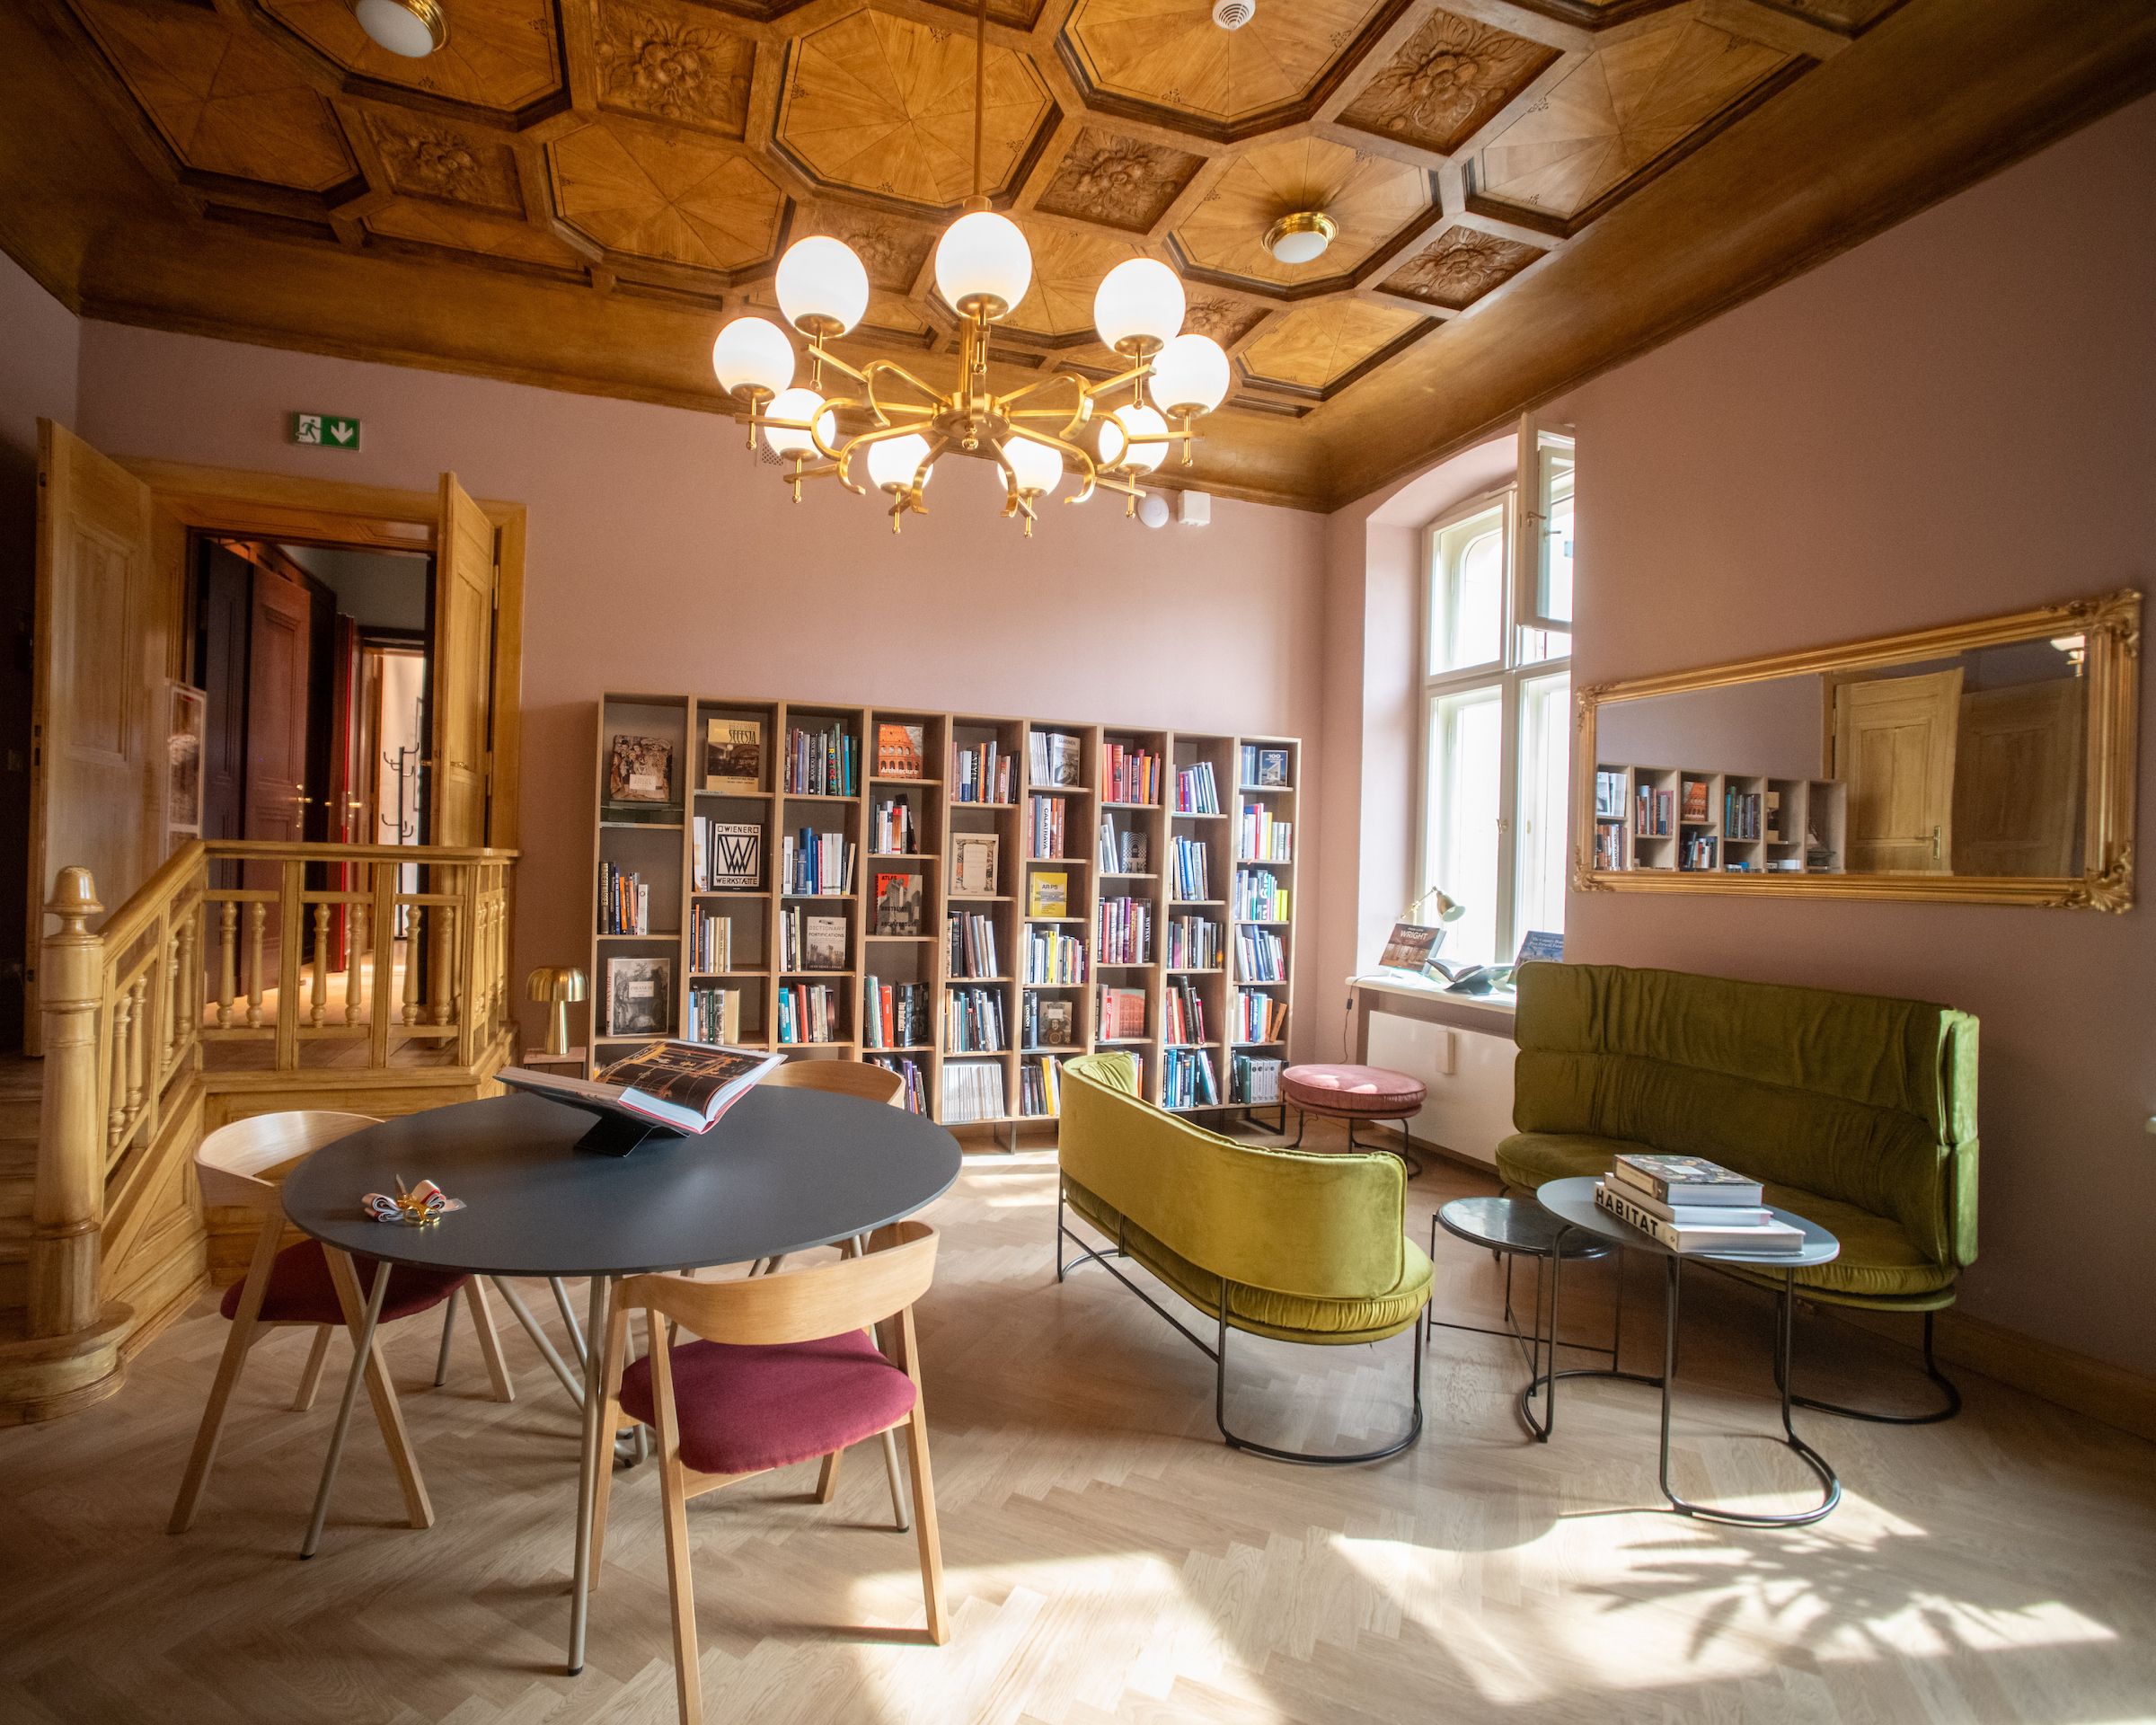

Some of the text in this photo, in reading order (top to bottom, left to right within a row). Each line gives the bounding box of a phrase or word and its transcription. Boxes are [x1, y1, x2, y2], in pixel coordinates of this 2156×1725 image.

[724, 826, 753, 834] WIENER
[1400, 930, 1428, 941] WRIGHT
[1595, 1188, 1658, 1236] HABITAT
